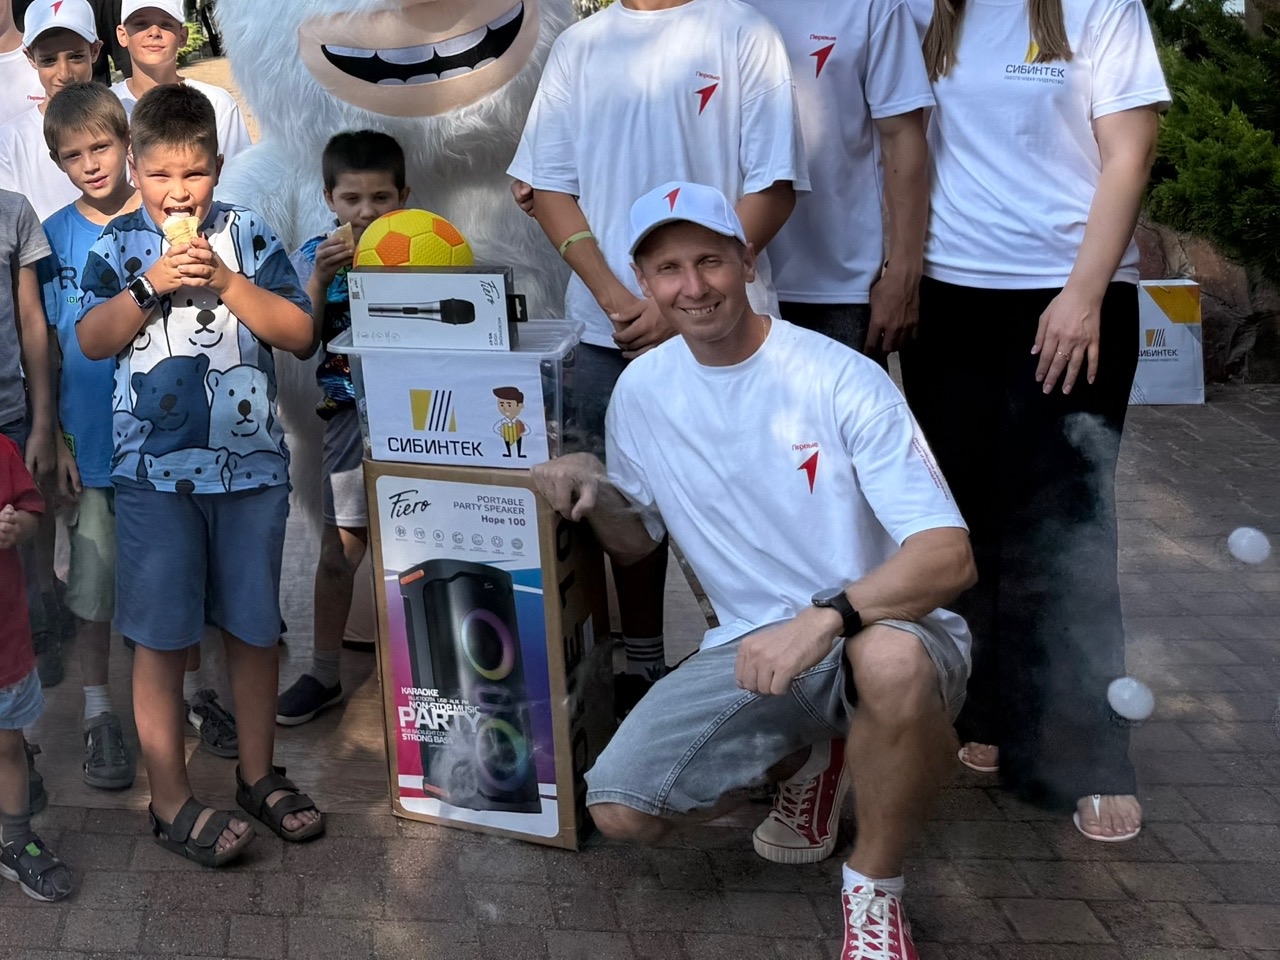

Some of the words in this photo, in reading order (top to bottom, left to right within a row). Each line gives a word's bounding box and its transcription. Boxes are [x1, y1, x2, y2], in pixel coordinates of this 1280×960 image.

[1005, 64, 1065, 78] СИБИНТЕК
[480, 280, 500, 305] Fiero
[1138, 349, 1178, 357] ИБИНТЕК
[387, 437, 484, 457] СИБИНТЕК
[388, 489, 432, 519] Fiero
[476, 494, 525, 507] PORTABLE
[453, 501, 482, 512] PARTY
[484, 504, 525, 515] SPEAKER
[481, 514, 505, 525] Hope
[508, 516, 526, 526] 100
[401, 687, 440, 697] KARAOKE
[409, 701, 453, 712] NON-STOP
[453, 705, 481, 714] MUSIC
[398, 705, 482, 733] PARTY
[402, 733, 433, 742] STRONG
